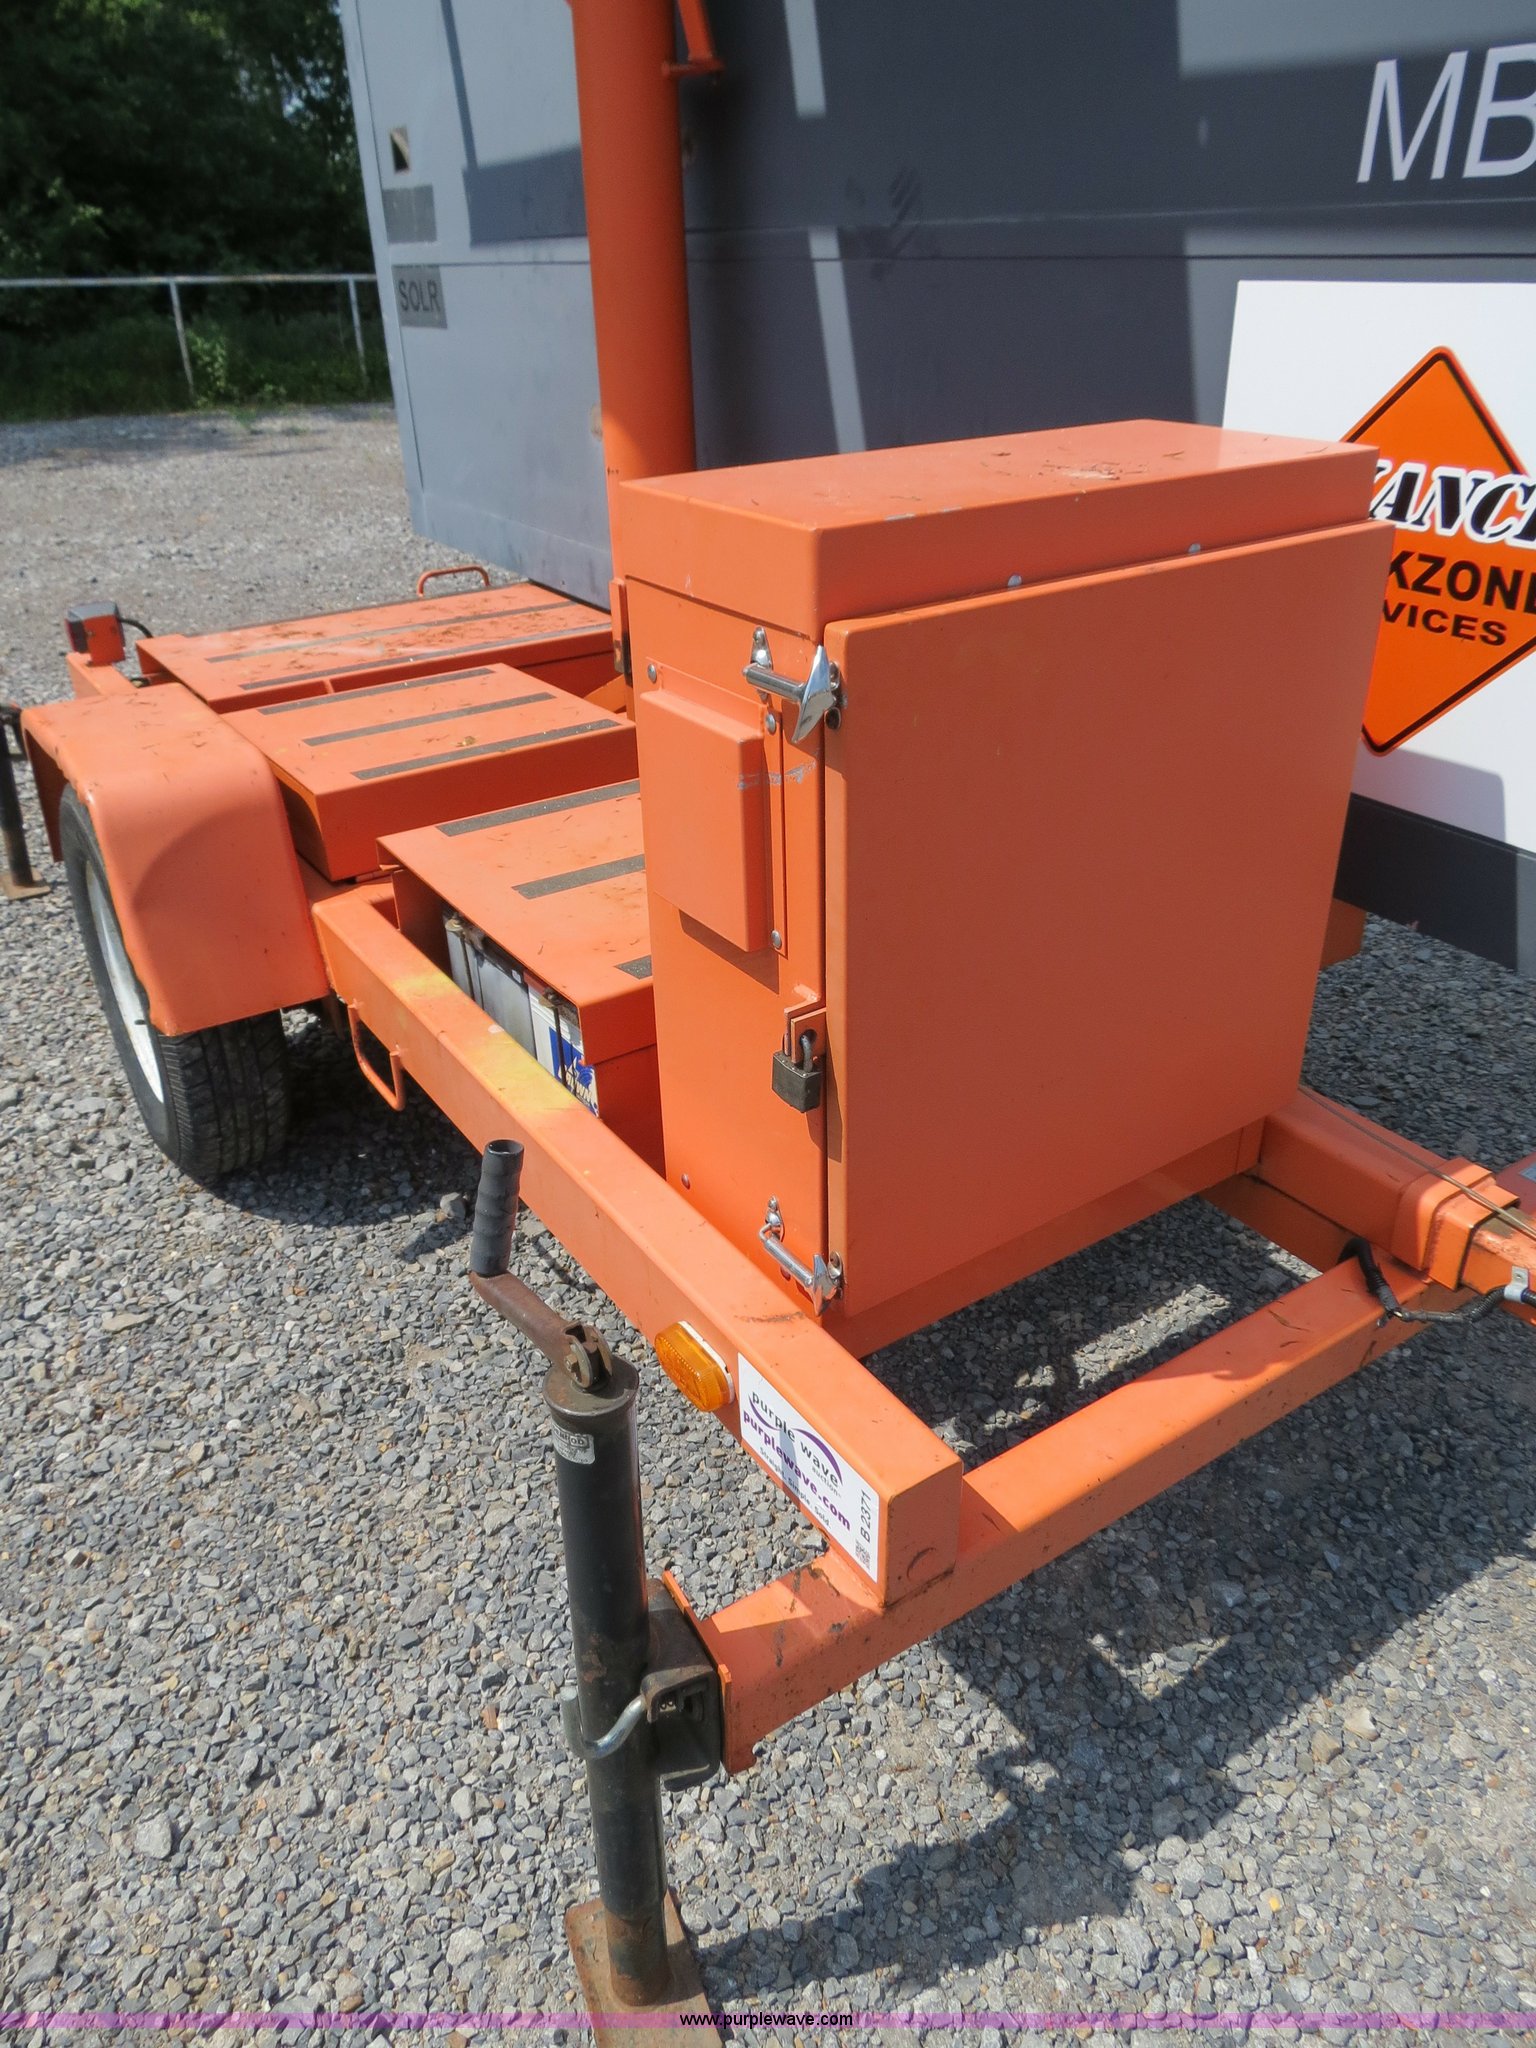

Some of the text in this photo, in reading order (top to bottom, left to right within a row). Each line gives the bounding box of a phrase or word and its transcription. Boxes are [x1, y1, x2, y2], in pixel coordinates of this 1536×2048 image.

[399, 280, 442, 313] SOLR
[743, 1410, 851, 1532] purplewave.com
[752, 1391, 839, 1488] purple wave
